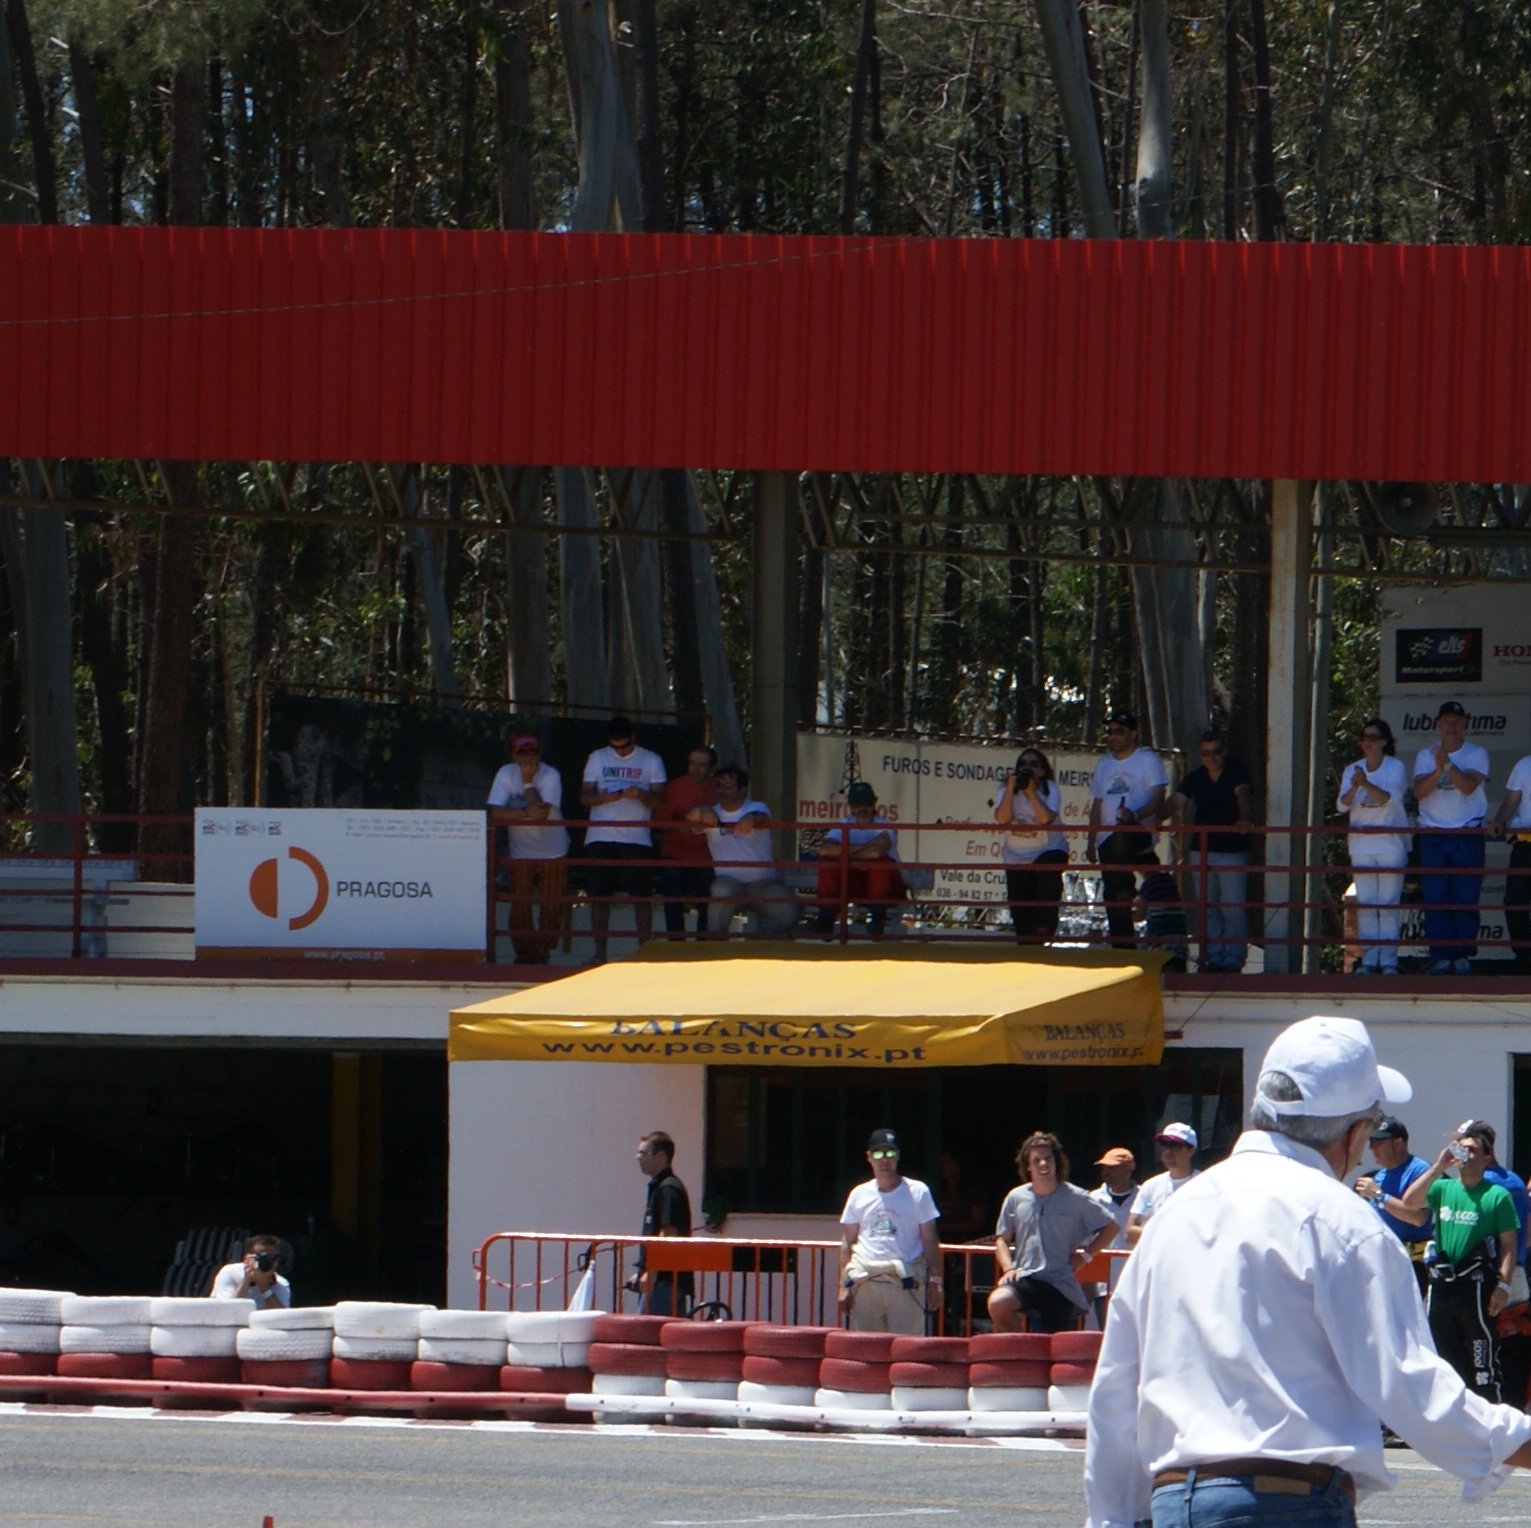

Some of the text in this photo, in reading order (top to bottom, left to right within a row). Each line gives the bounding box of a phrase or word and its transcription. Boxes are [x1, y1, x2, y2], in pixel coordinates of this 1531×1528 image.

[602, 766, 643, 779] UNITRIP
[882, 755, 931, 776] FUROS
[934, 760, 943, 777] E
[984, 872, 1009, 885] Cru
[336, 881, 433, 898] PRAGOSA
[613, 1019, 857, 1042] BALANÇAS
[1044, 1022, 1127, 1043] BALANÇAS
[541, 1040, 928, 1064] www.pestronix.pt
